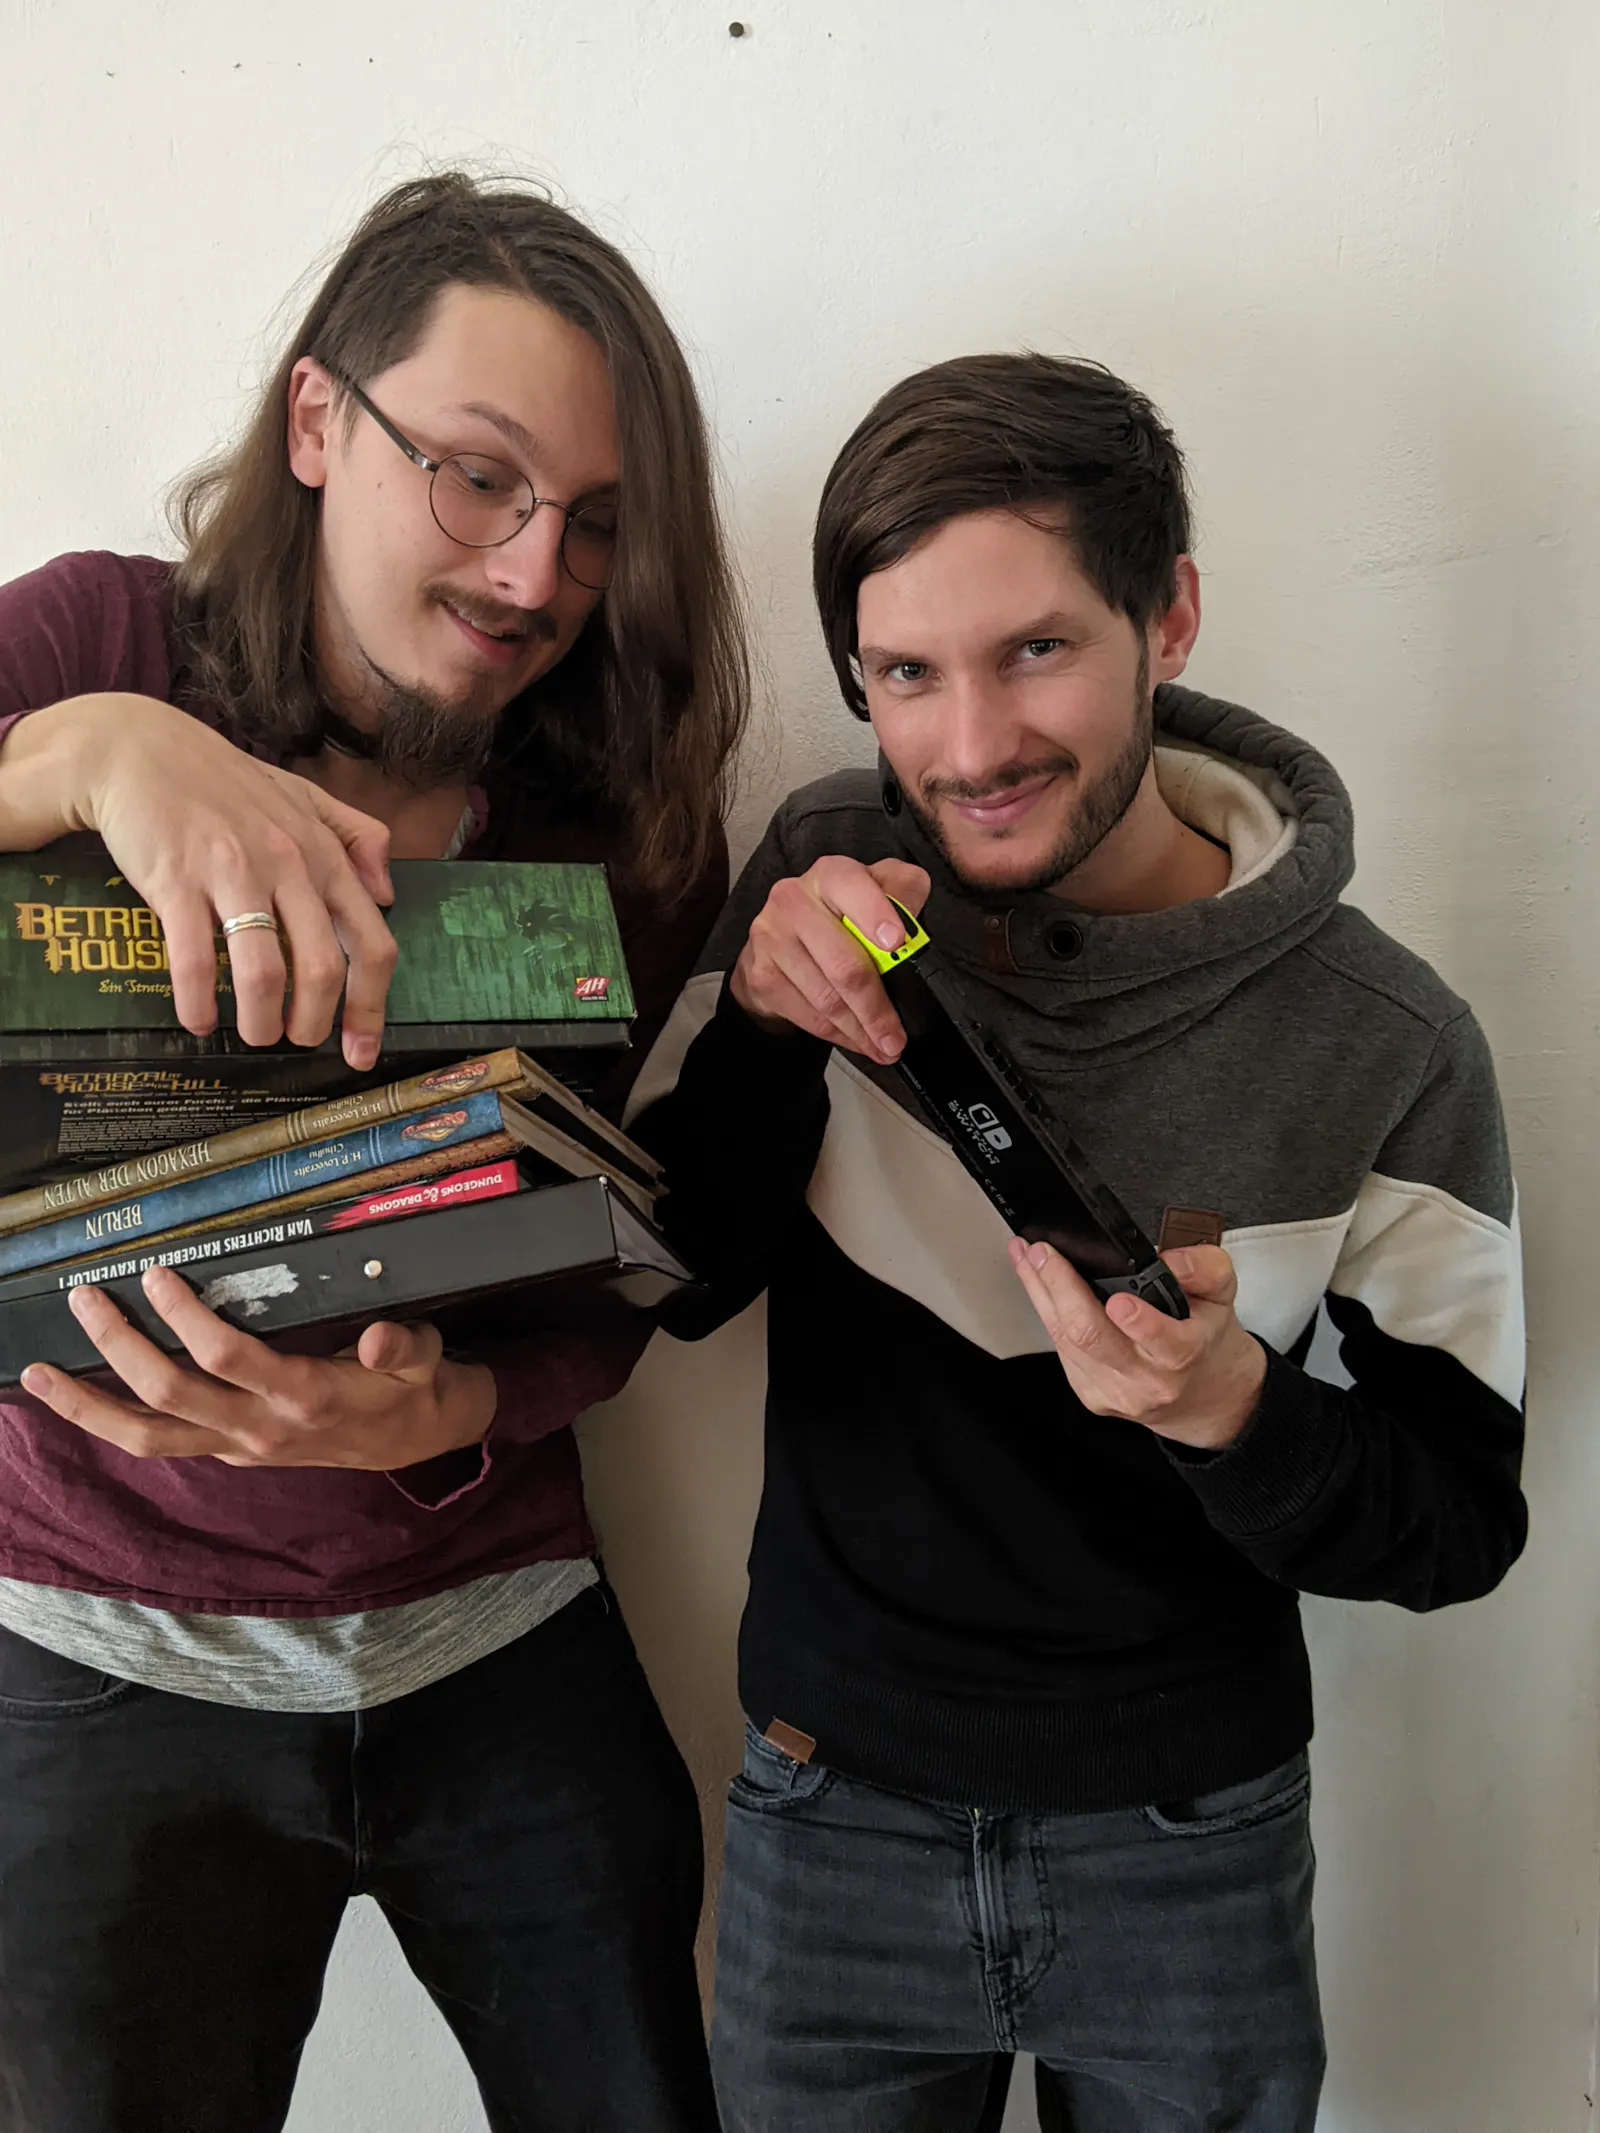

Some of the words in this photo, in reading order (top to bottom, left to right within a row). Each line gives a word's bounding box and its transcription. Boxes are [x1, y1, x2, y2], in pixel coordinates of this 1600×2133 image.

[14, 902, 160, 941] BETRA
[98, 979, 122, 994] Ein
[124, 979, 174, 997] Strateg
[577, 978, 605, 994] AH
[39, 1071, 168, 1086] BETRAYAL
[55, 1080, 143, 1094] HOUSE
[170, 1078, 229, 1091] HILL
[312, 1109, 359, 1128] Lovecrafts
[948, 1101, 996, 1165] SWITCH
[309, 1143, 344, 1158] Cthulhu
[136, 1141, 213, 1180] HEXAGON
[293, 1157, 339, 1177] Lovecrafts
[98, 1165, 131, 1193] DER
[441, 1173, 502, 1197] DUNGEONS
[44, 1178, 93, 1209] ALTEN
[422, 1187, 438, 1203] &
[369, 1195, 422, 1214] DRAGONS
[85, 1204, 143, 1240] BERLIN
[288, 1219, 314, 1237] VAN
[158, 1240, 222, 1266] RATGEBER
[140, 1257, 159, 1272] ZU
